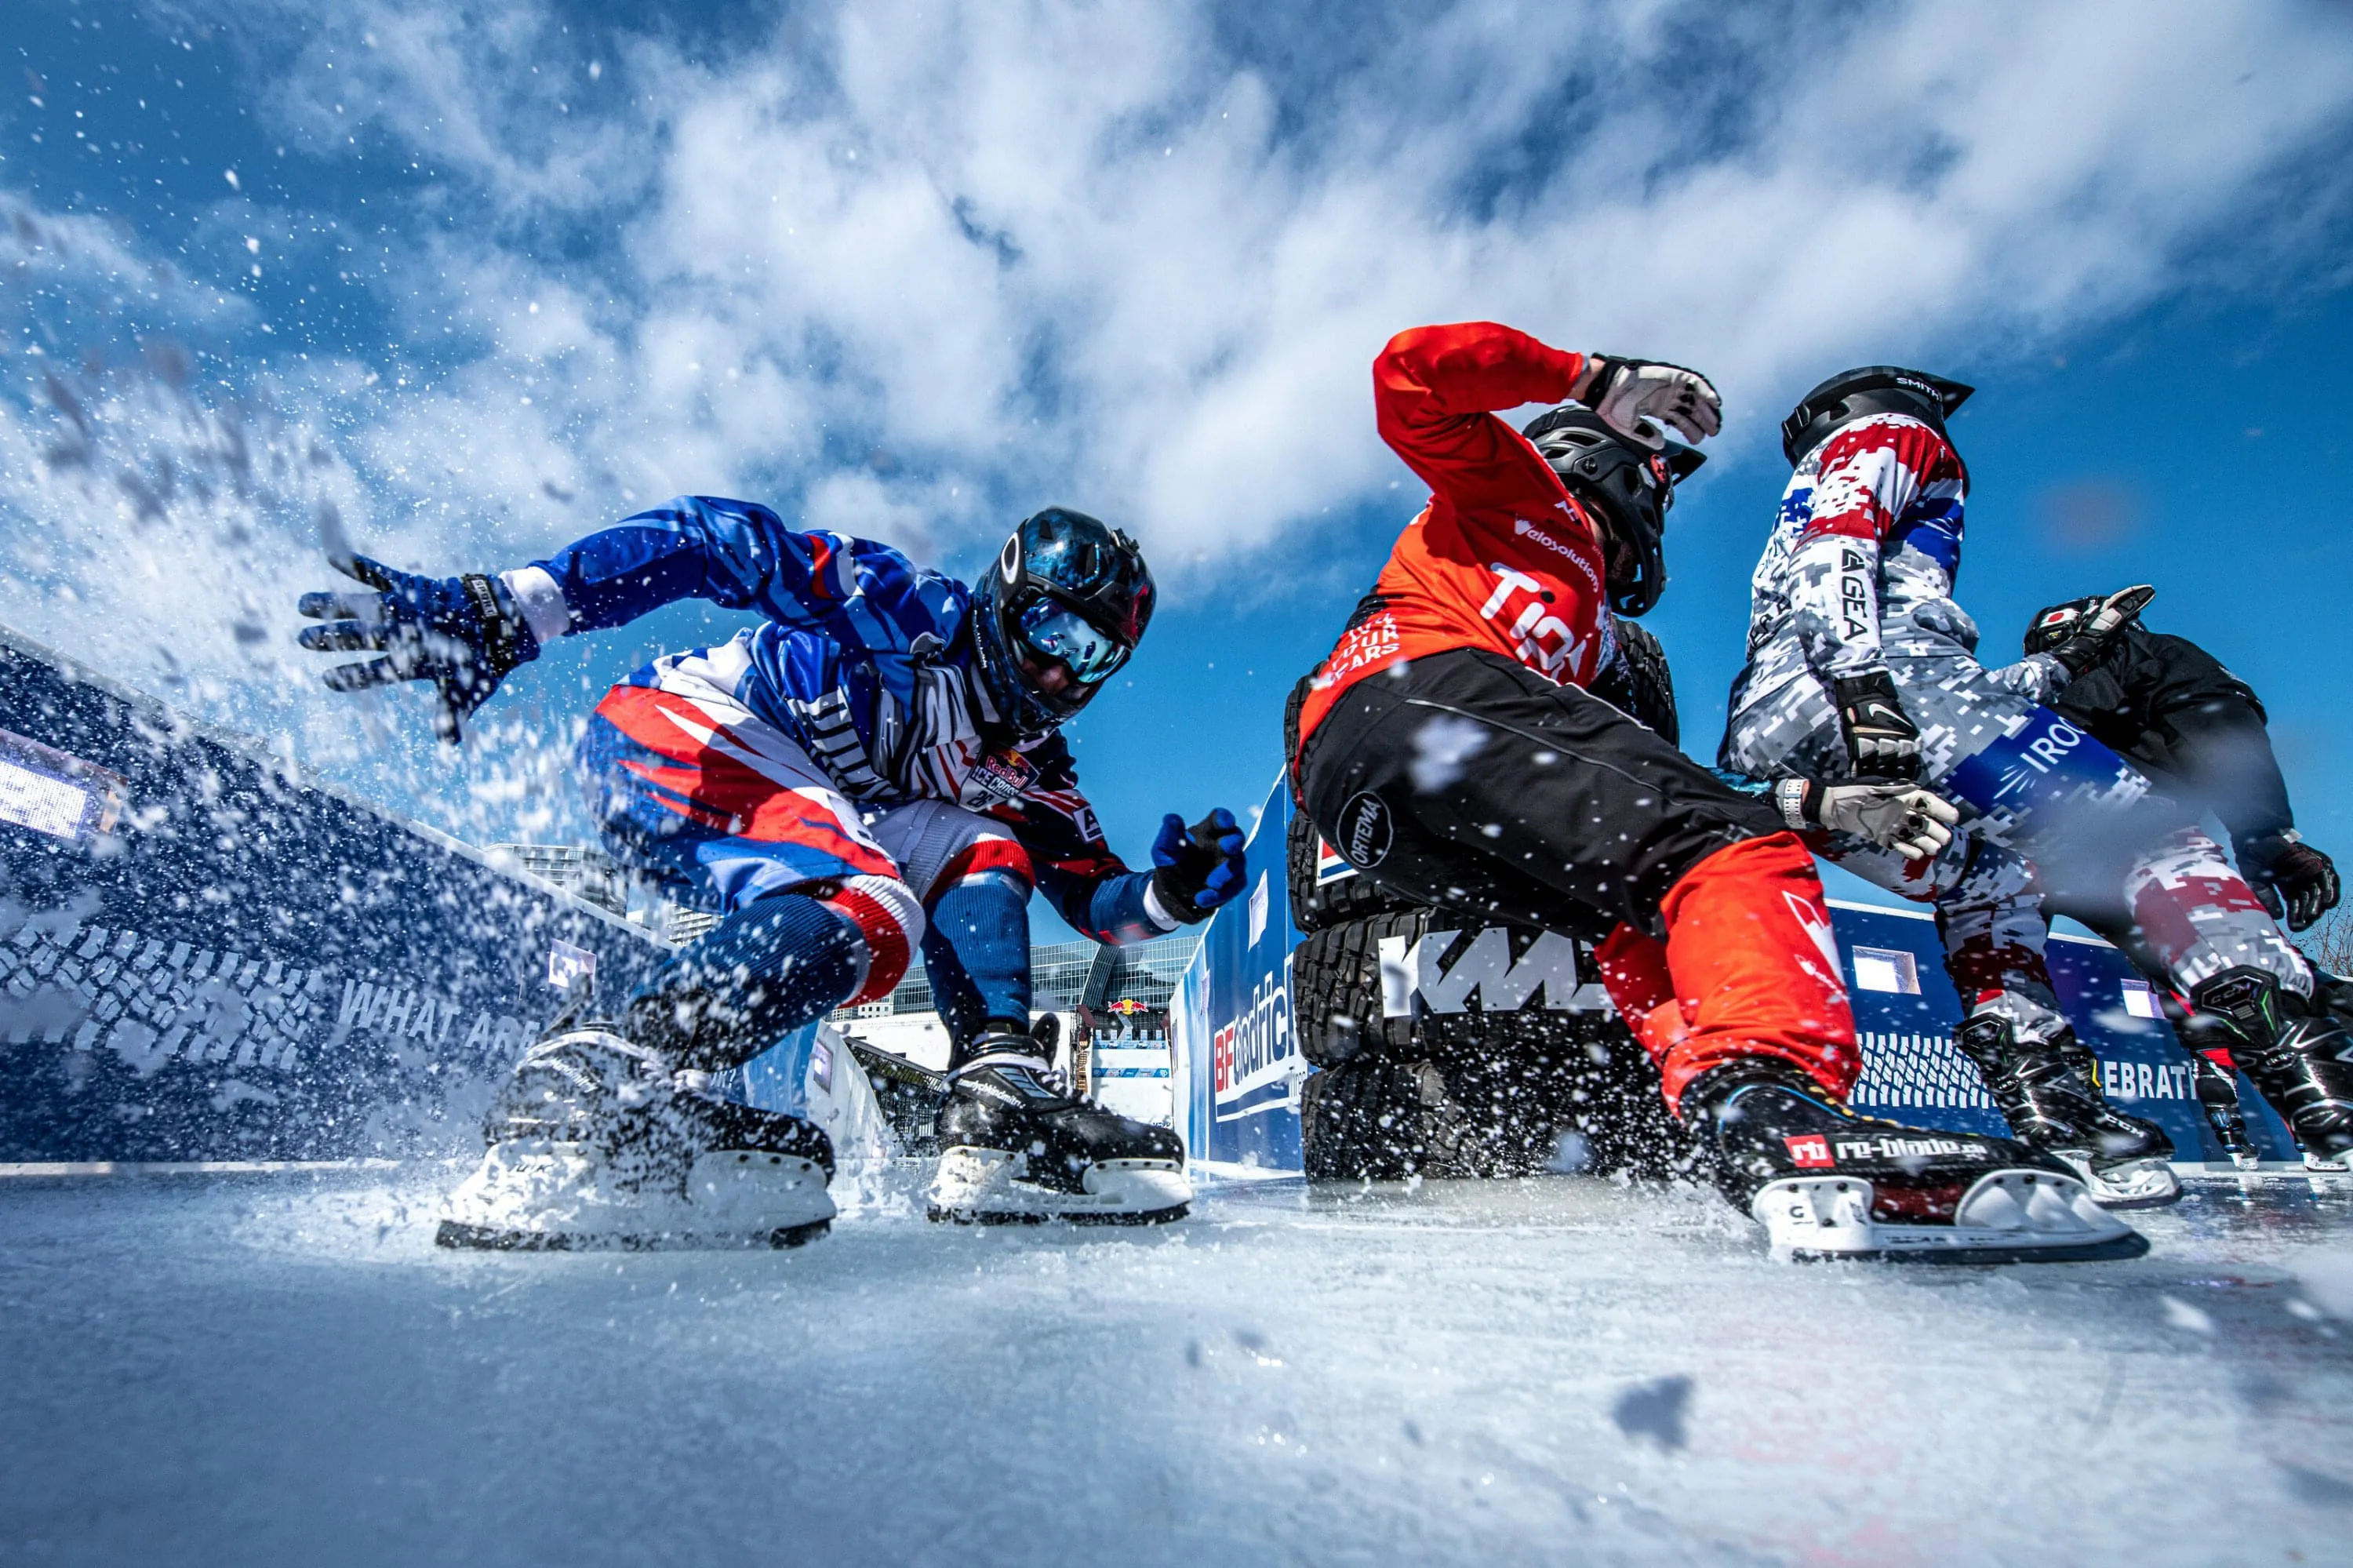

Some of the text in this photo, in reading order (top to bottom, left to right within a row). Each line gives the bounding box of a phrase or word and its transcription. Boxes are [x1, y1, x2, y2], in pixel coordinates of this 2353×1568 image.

[1896, 377, 1940, 401] SMITH
[972, 765, 994, 786] ICE
[985, 755, 1029, 789] Red Bull
[1351, 799, 1382, 864] ORTEMA
[337, 978, 461, 1045] WHAT
